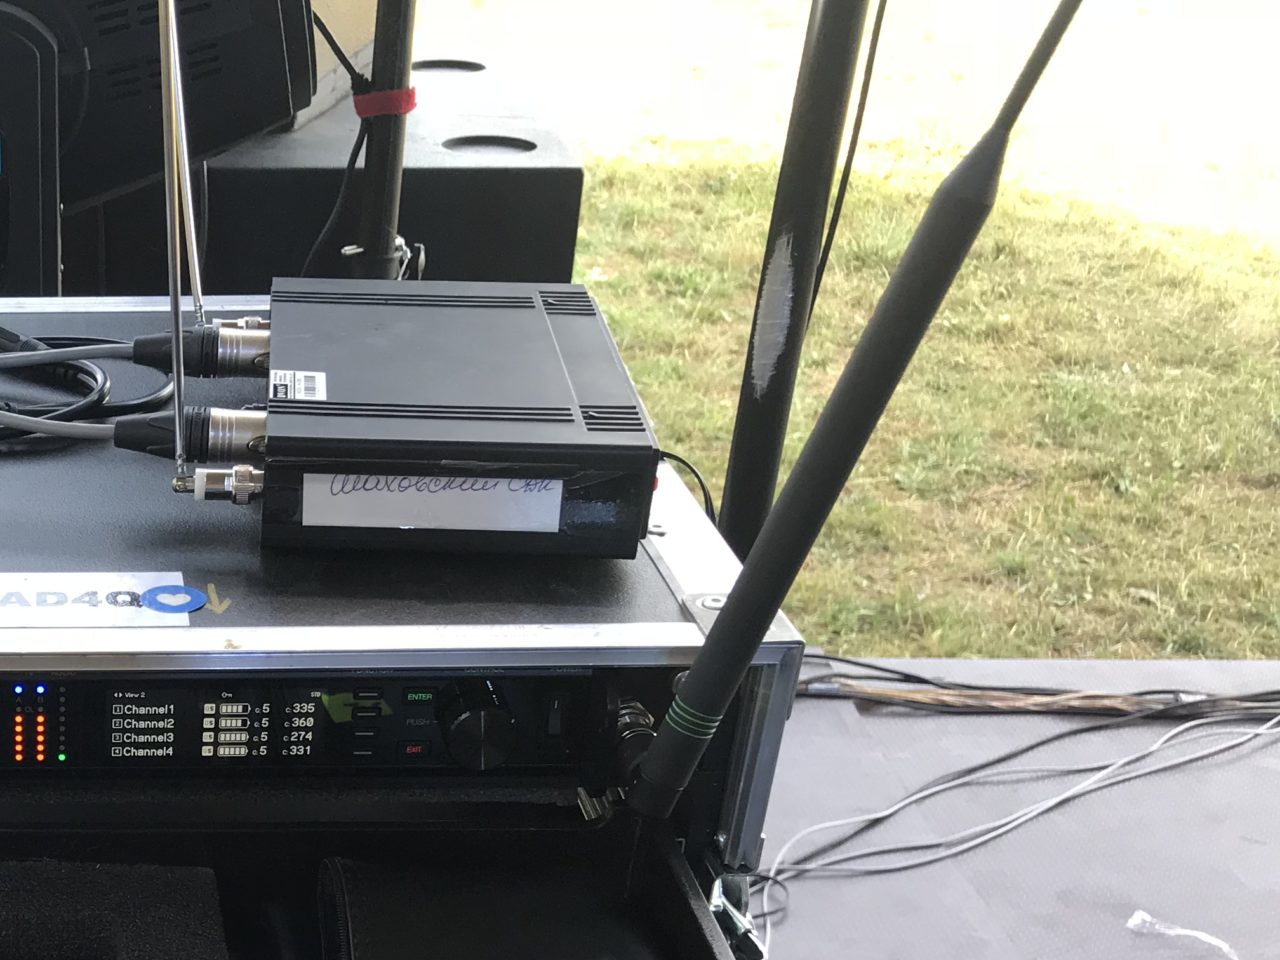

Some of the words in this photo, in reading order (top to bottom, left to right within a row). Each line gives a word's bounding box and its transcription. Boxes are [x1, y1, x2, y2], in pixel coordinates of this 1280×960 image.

[407, 693, 433, 701] ENTER
[124, 704, 174, 714] Channel1
[123, 718, 175, 728] Channel2
[123, 732, 174, 742] Channel3
[123, 746, 173, 756] Channel4
